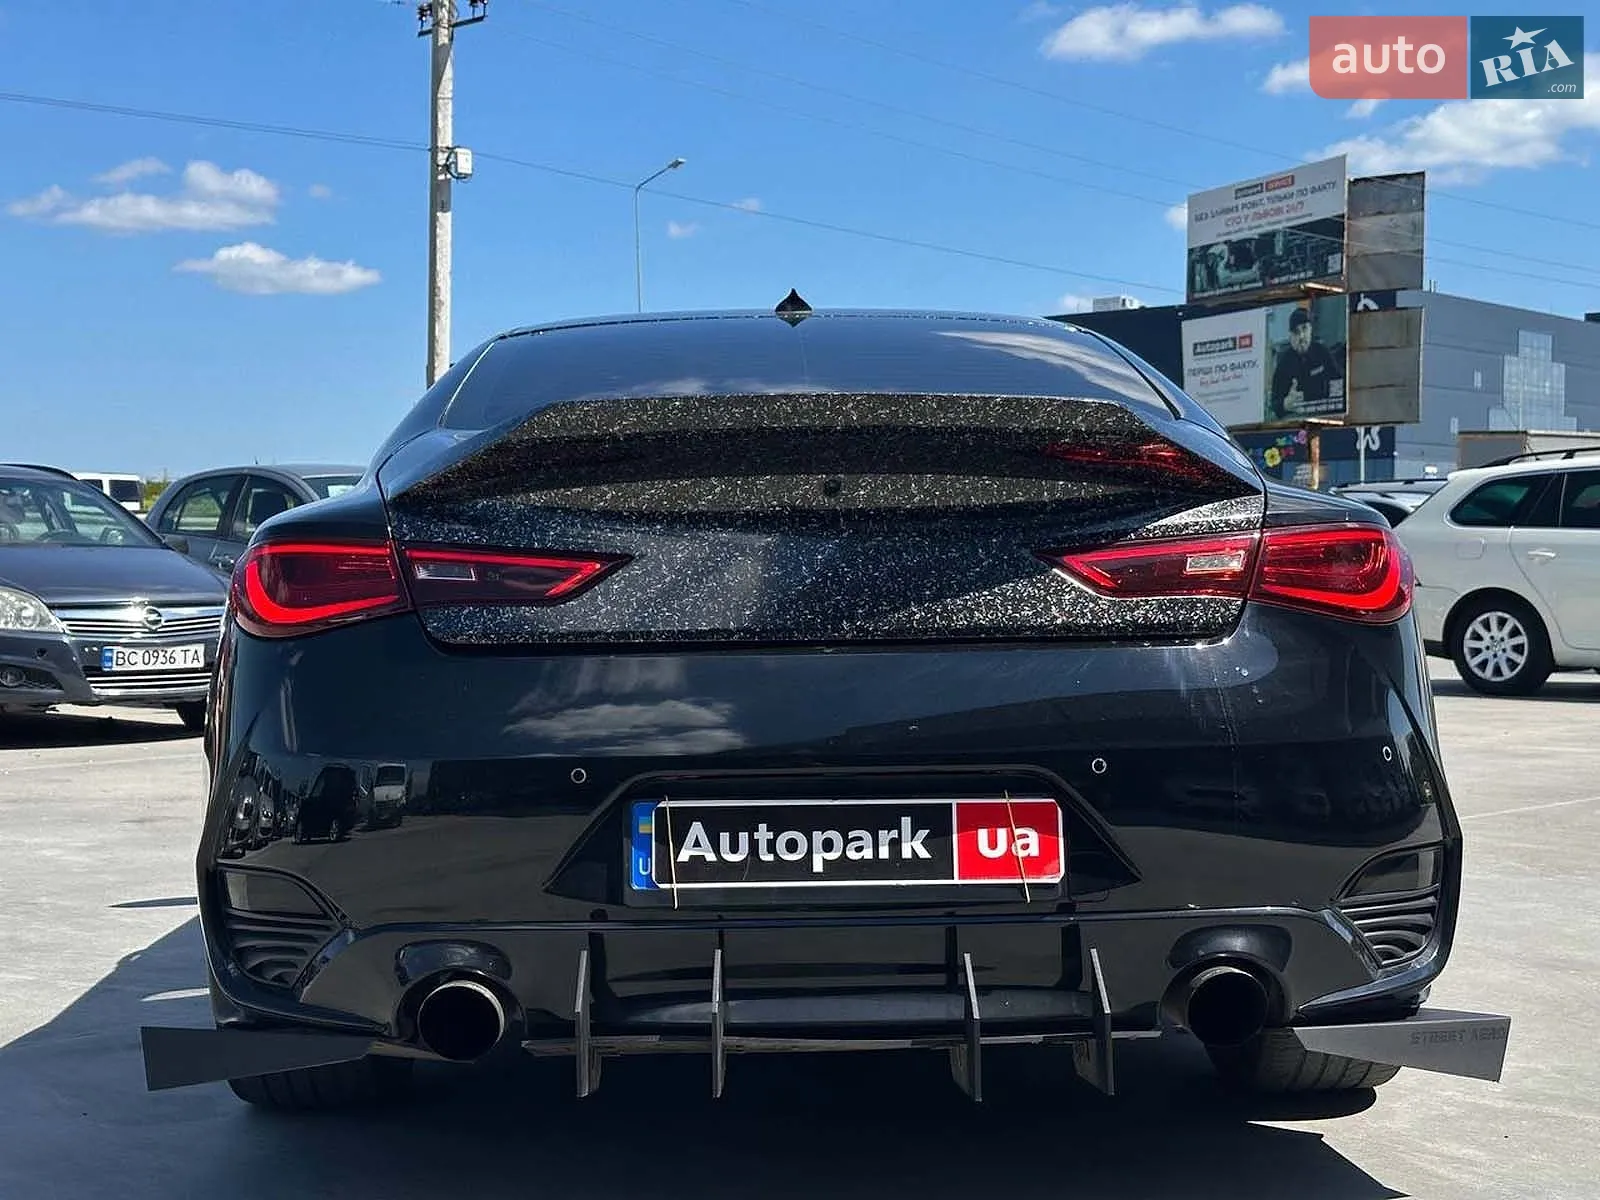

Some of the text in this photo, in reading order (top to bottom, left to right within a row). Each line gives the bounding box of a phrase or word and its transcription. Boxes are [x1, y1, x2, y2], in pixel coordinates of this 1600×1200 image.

[115, 649, 200, 666] BC 0936 TA
[676, 816, 1040, 872] Autopark ua
[639, 857, 651, 875] U
